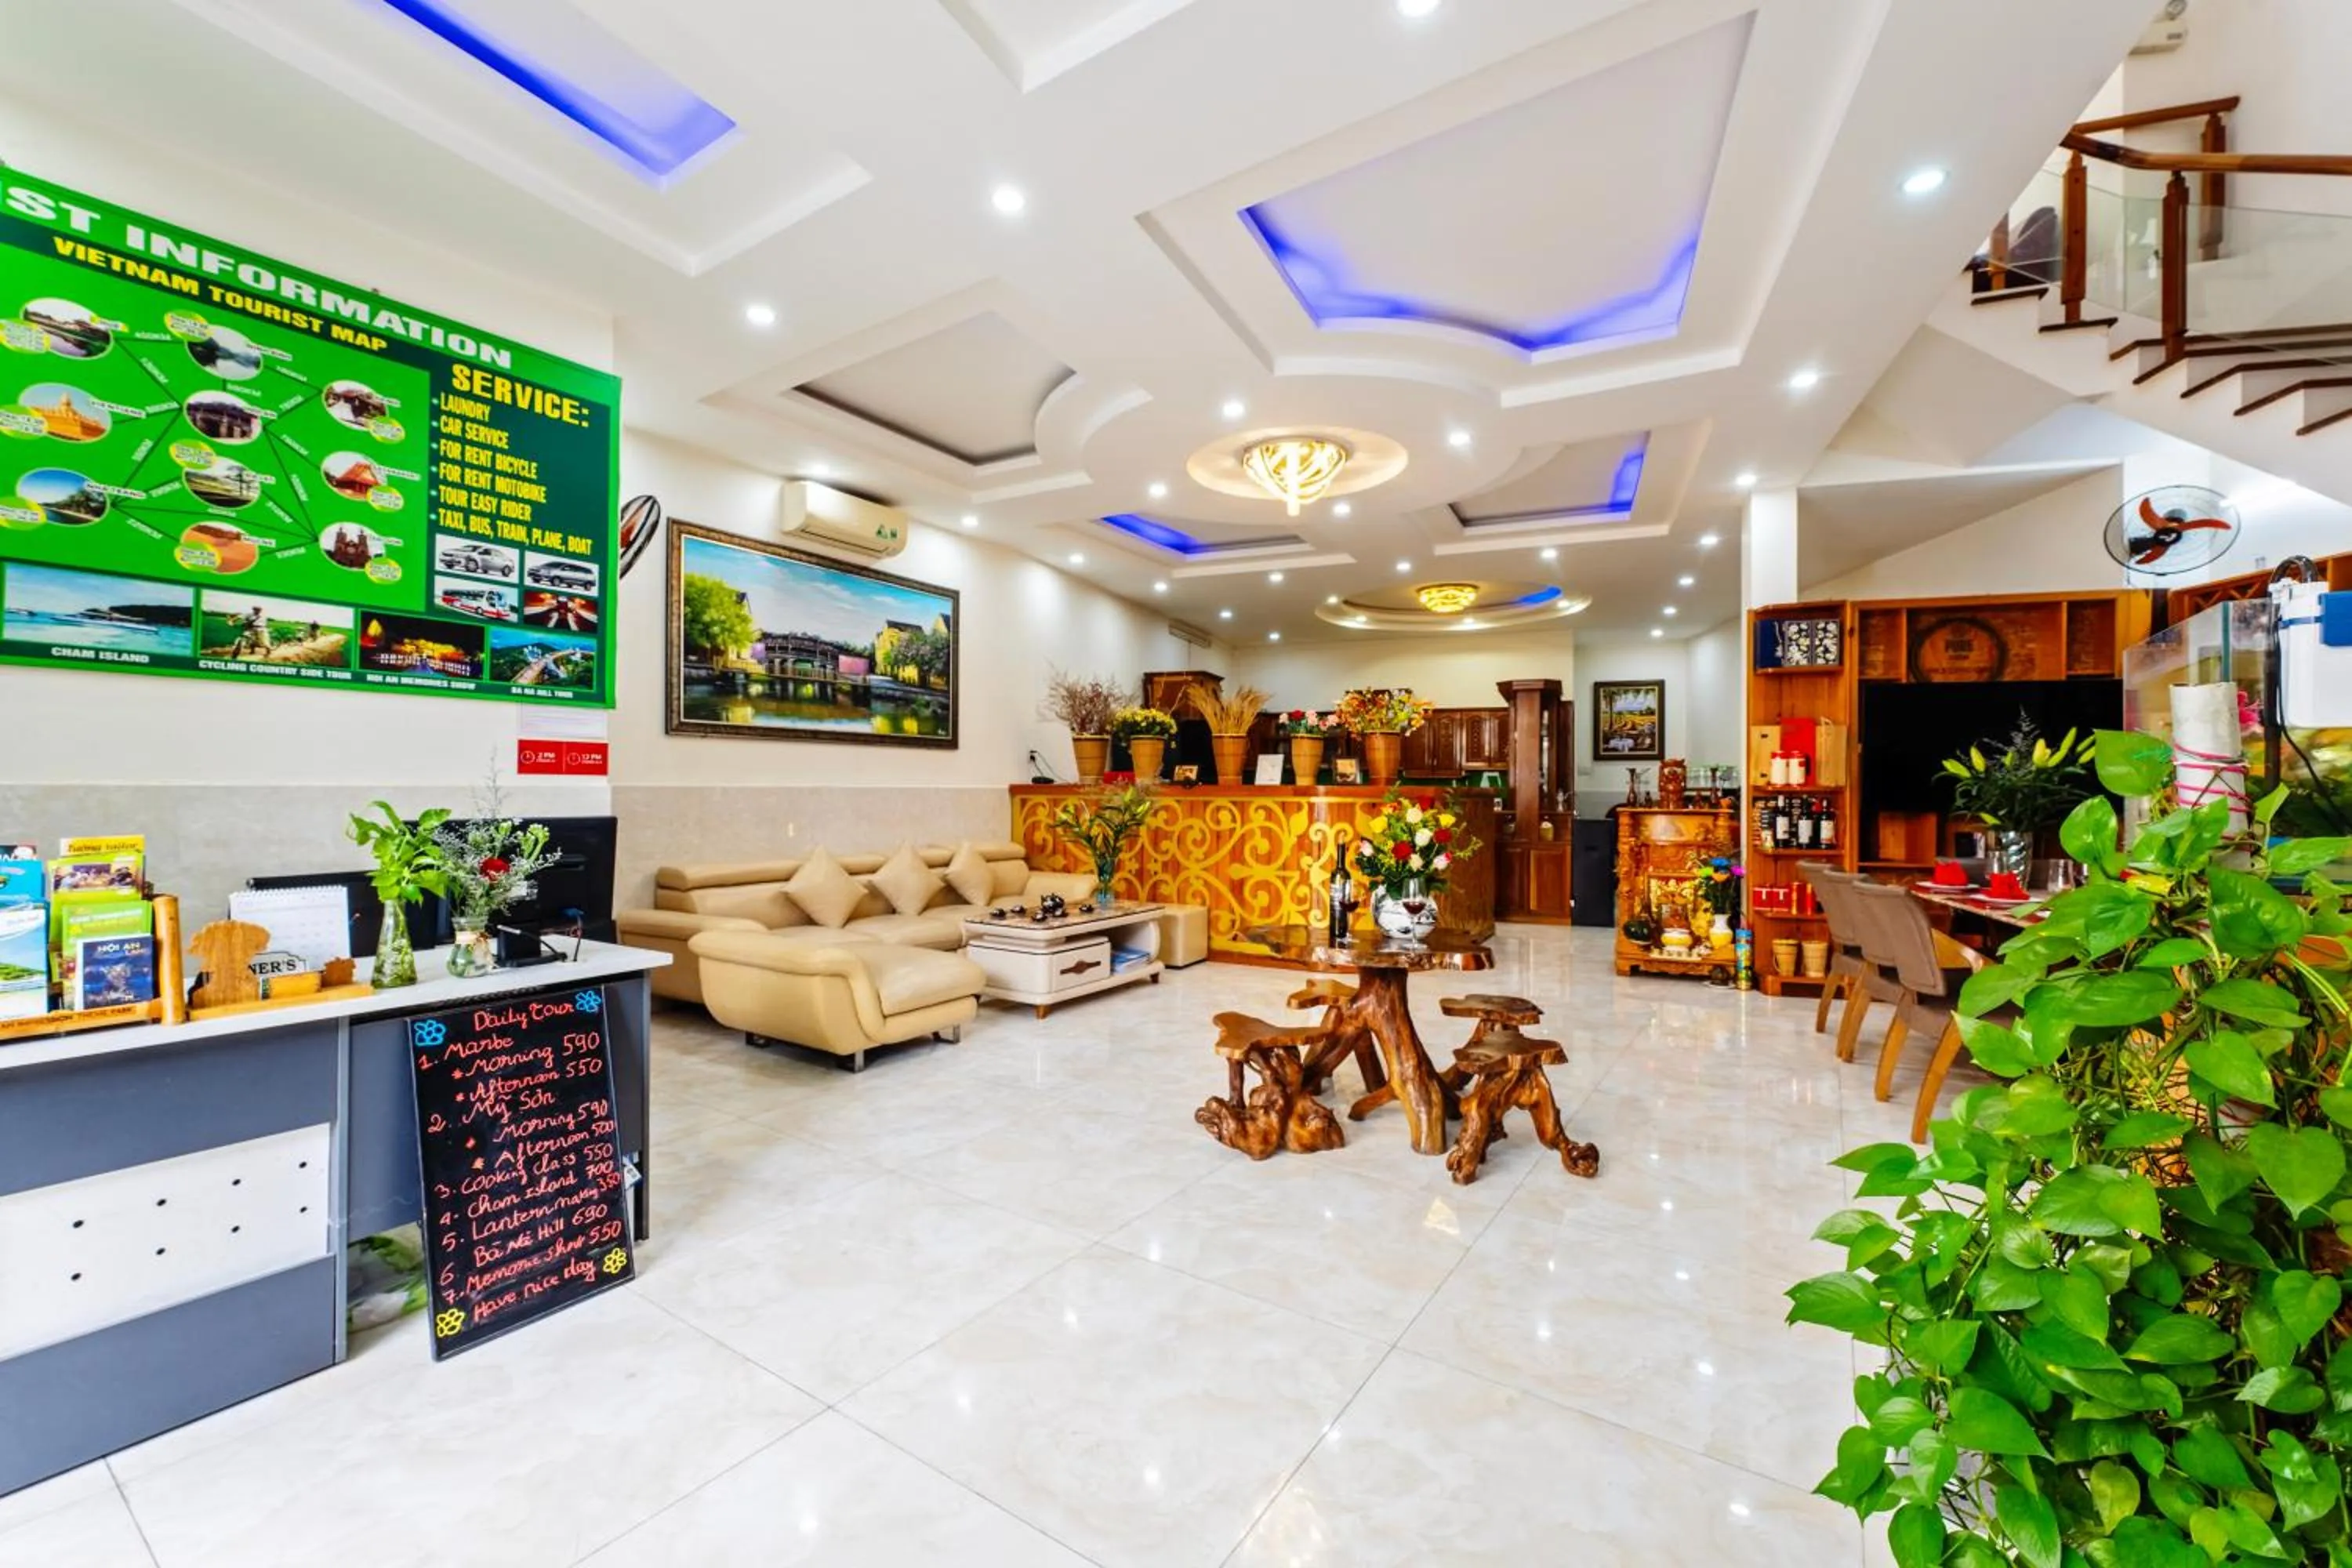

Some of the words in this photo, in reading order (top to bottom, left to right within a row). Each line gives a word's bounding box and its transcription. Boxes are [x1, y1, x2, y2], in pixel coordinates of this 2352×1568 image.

[0, 183, 101, 234] ST
[125, 223, 512, 369] INFORMATION
[53, 236, 199, 296] VIETNAM
[209, 285, 323, 333] TOURIST
[330, 324, 387, 350] MAP
[440, 391, 491, 423] LAUNDRY
[452, 364, 590, 427] SERVICE:
[440, 415, 463, 437] CAR
[465, 422, 509, 449] SERVICE
[439, 438, 462, 460] FOR
[464, 445, 492, 468] RENT
[495, 452, 538, 480] BICYCLE
[438, 461, 461, 483] FOR
[464, 467, 492, 490] RENT
[495, 474, 546, 503] MOTOBIKE
[438, 484, 469, 508] TOUR
[470, 492, 498, 514] EASY
[500, 498, 532, 522] RIDER
[438, 507, 466, 534] TAXI,
[469, 514, 493, 539] BUS,
[495, 519, 529, 546] TRAIN,
[532, 527, 565, 553] PLANE,
[568, 535, 592, 556] BOAT
[51, 647, 96, 661] CHAM
[99, 650, 150, 664] ISLAND
[198, 659, 247, 672] CYCLING
[249, 663, 296, 676] COUNTRY
[299, 668, 324, 678] SIDE
[326, 670, 351, 681] TOUR
[450, 681, 476, 690] SHOW
[474, 1006, 528, 1032] Daily
[562, 1031, 600, 1057] 590
[565, 1058, 603, 1078] 550
[576, 1098, 608, 1121] 590
[461, 1167, 528, 1194] Cooking
[583, 1142, 613, 1161] 550
[585, 1160, 614, 1180] 700
[472, 1205, 555, 1240] Lantern
[538, 1217, 564, 1240] Hill
[572, 1203, 608, 1225] 690
[589, 1220, 622, 1244] 550
[473, 1293, 517, 1323] Have
[524, 1276, 561, 1299] nice
[564, 1257, 597, 1282] day
